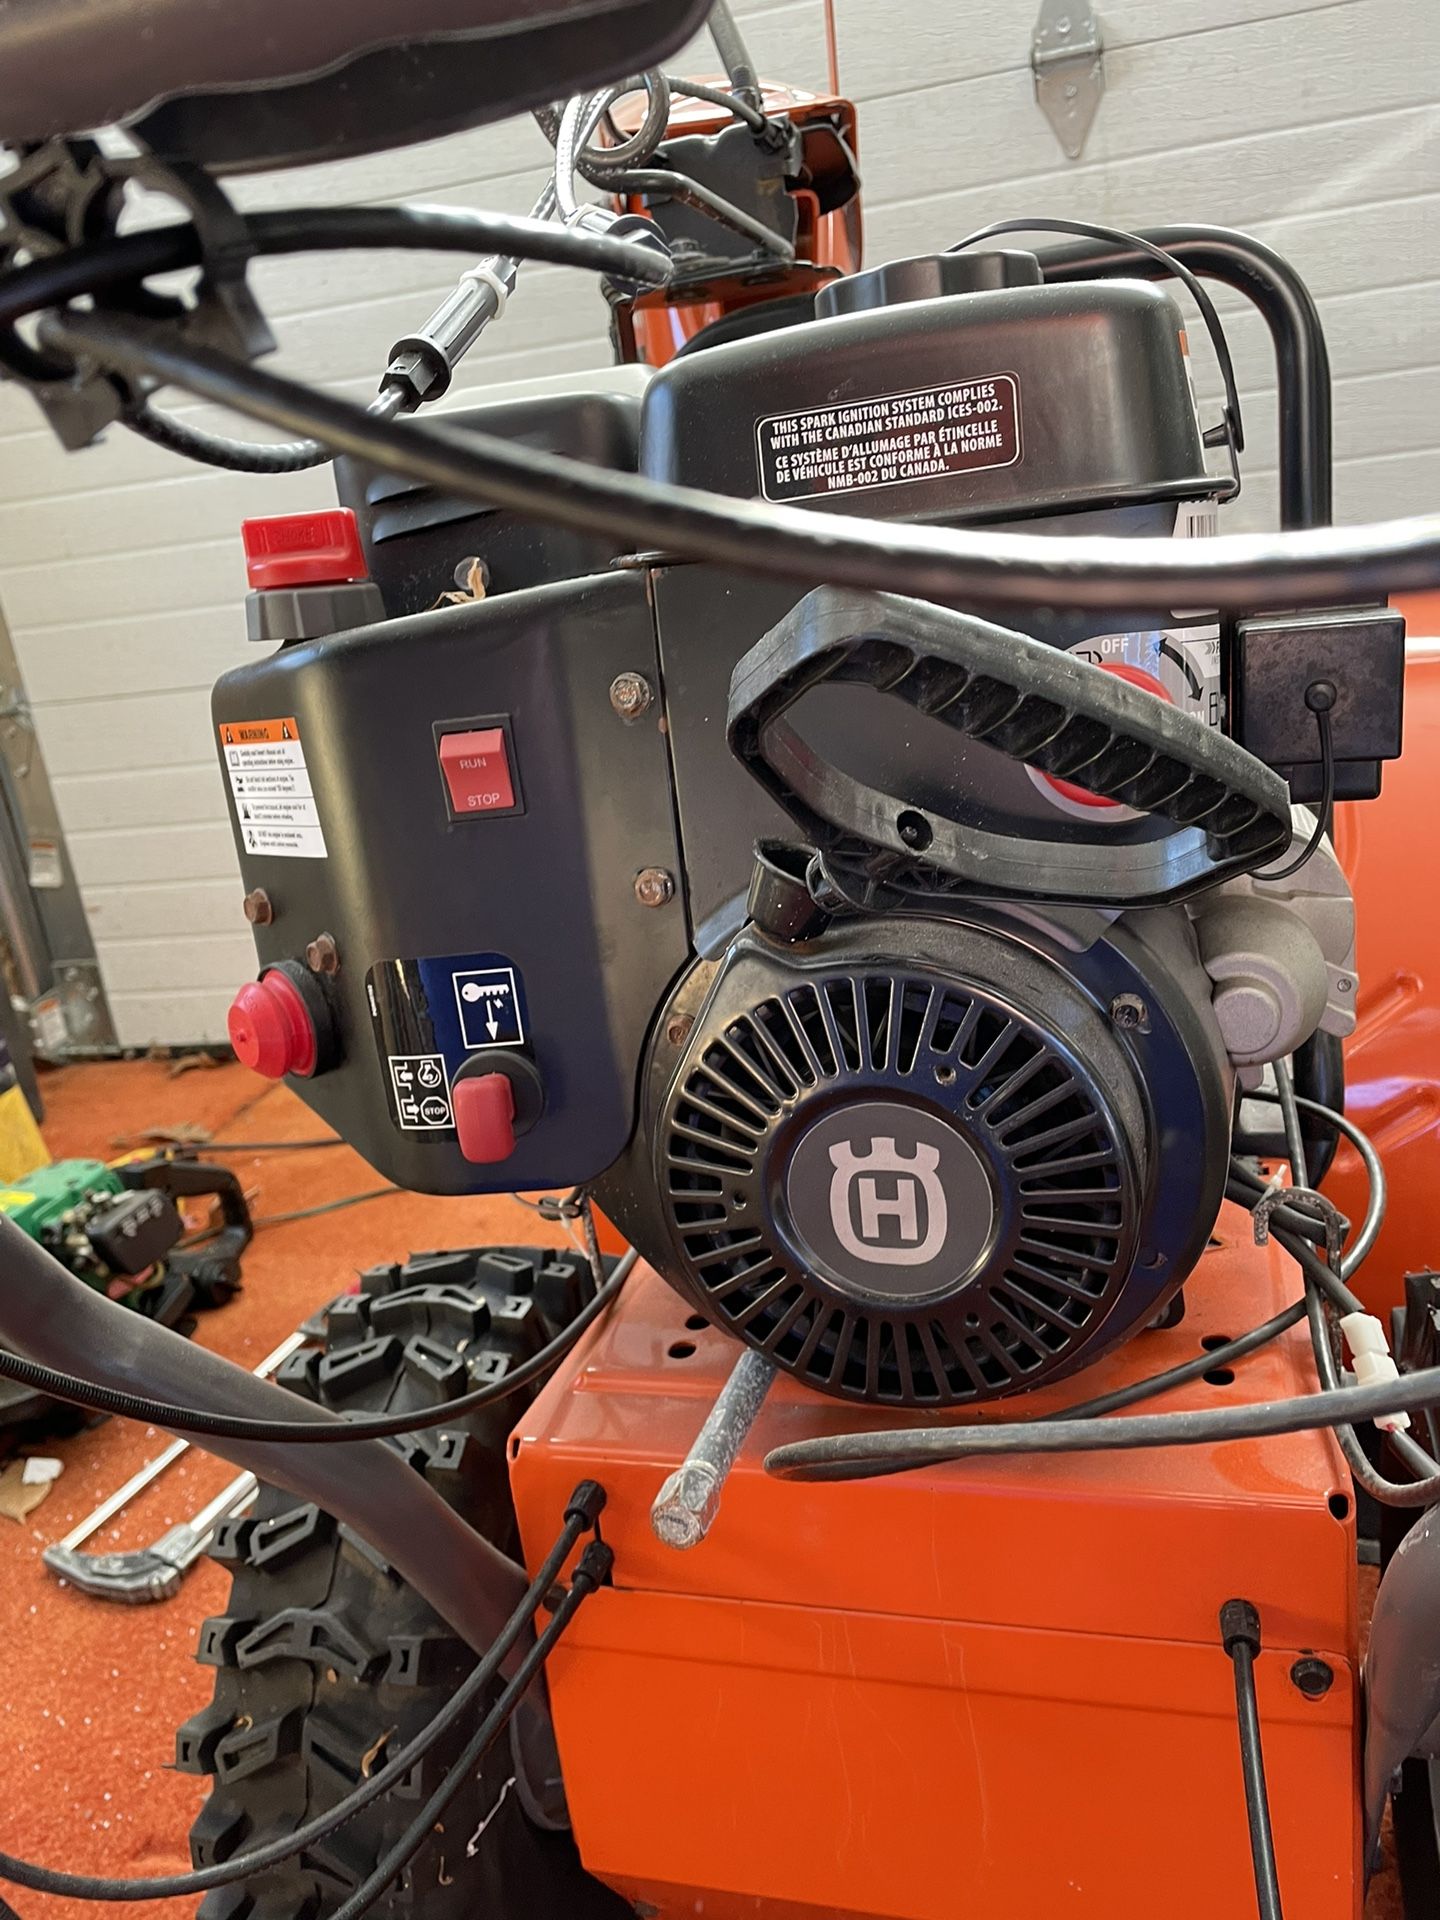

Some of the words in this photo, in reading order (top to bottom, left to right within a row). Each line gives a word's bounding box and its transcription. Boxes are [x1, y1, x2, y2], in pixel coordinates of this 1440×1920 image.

[770, 433, 799, 450] WITH
[801, 429, 823, 445] THE
[825, 419, 882, 440] CANADIAN
[885, 408, 944, 430] STANDARD
[947, 399, 1003, 420] ICES-002.
[772, 419, 798, 435] THIS
[800, 412, 836, 431] SPARK
[838, 403, 889, 424] IGNITION
[892, 395, 935, 415] SYSTEM
[937, 383, 995, 406] COMPLIES
[775, 455, 789, 469] CE
[790, 447, 839, 467] SYSTÈME
[913, 431, 936, 446] PAR
[938, 419, 998, 442] ÉTINCELLE
[776, 470, 791, 484] DE
[792, 461, 845, 481] VÉHICULE
[847, 457, 867, 472] EST
[869, 446, 931, 468] CONFORME
[933, 442, 941, 458] À
[943, 441, 958, 456] LA
[961, 434, 1003, 453] NORME
[827, 470, 879, 490] NMB-002
[881, 466, 897, 481] DU
[900, 458, 950, 477] CANADA.
[1101, 638, 1129, 654] OFF
[459, 756, 487, 770] RUN
[467, 792, 500, 807] STOP
[424, 1106, 446, 1117] STOP
[858, 1177, 918, 1241] H
